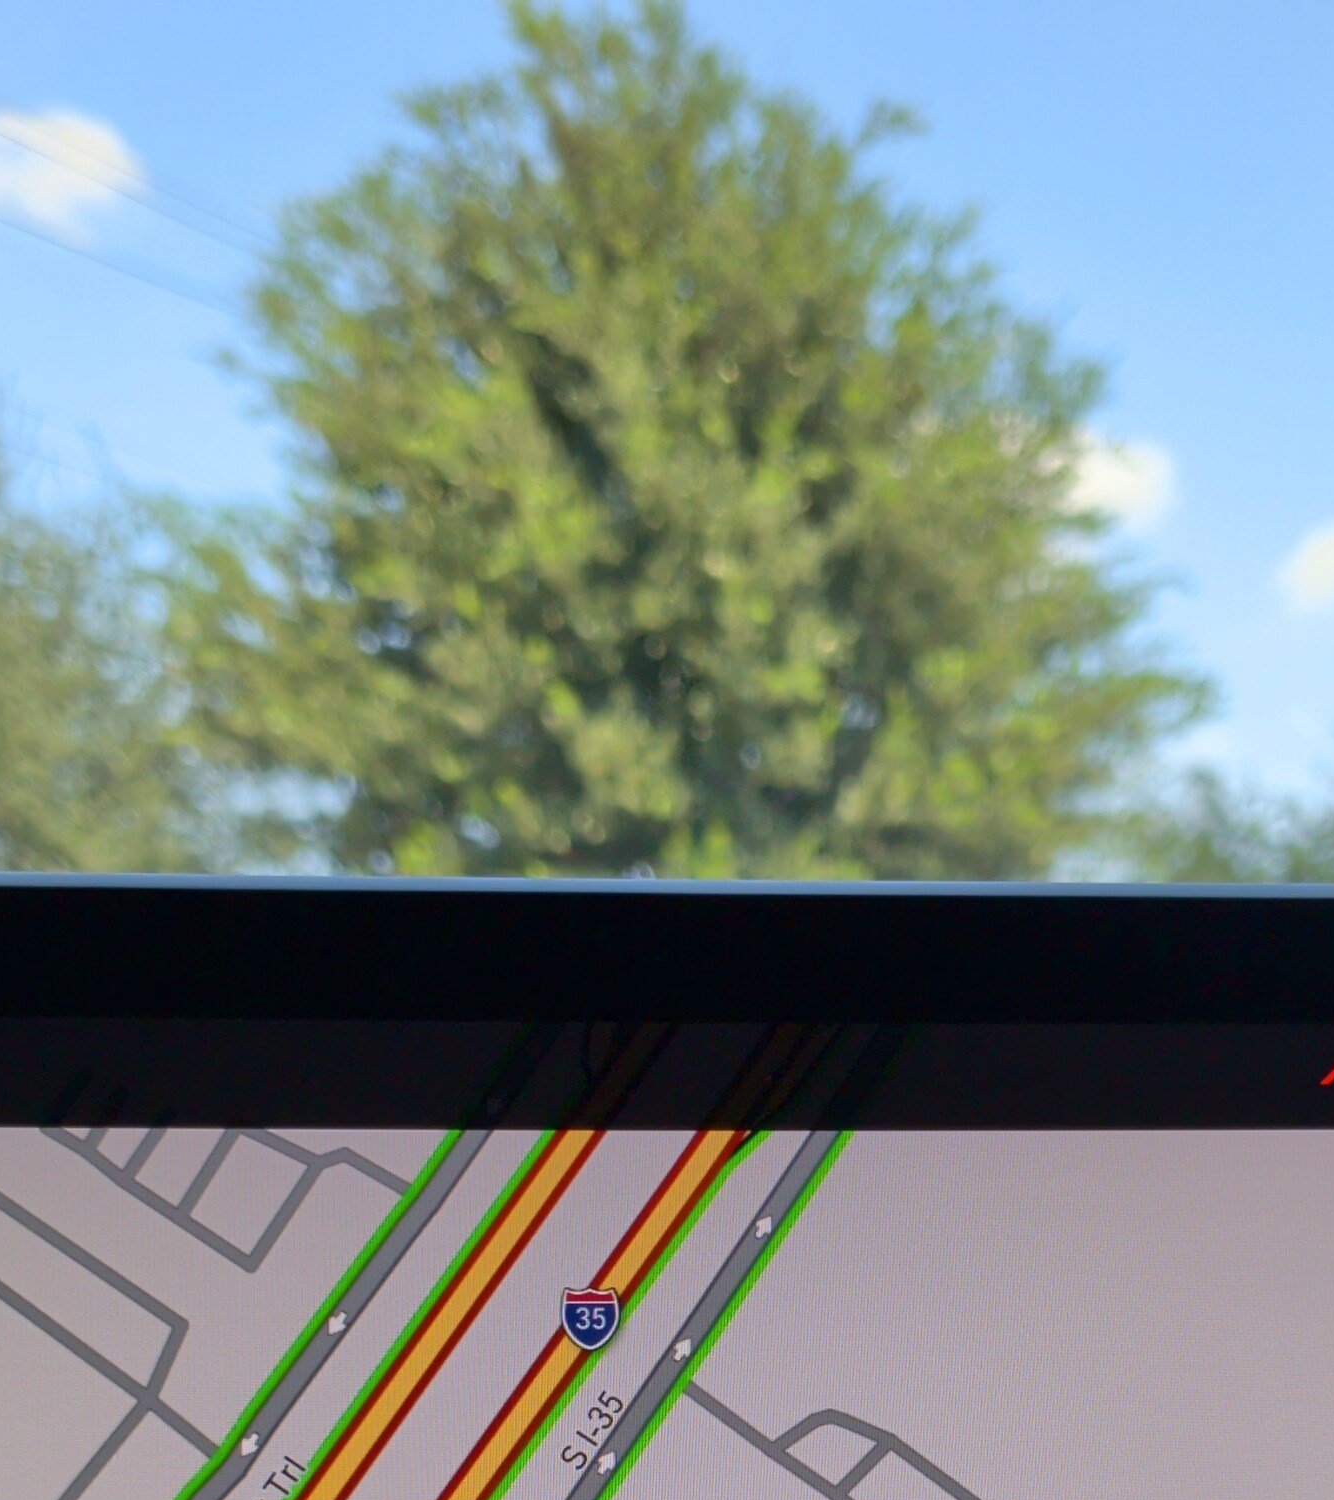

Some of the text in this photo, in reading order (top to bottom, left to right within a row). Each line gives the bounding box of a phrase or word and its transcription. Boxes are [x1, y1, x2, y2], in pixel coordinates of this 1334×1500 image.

[575, 1306, 607, 1331] 35
[560, 1445, 589, 1471] S
[262, 1455, 307, 1496] Trl
